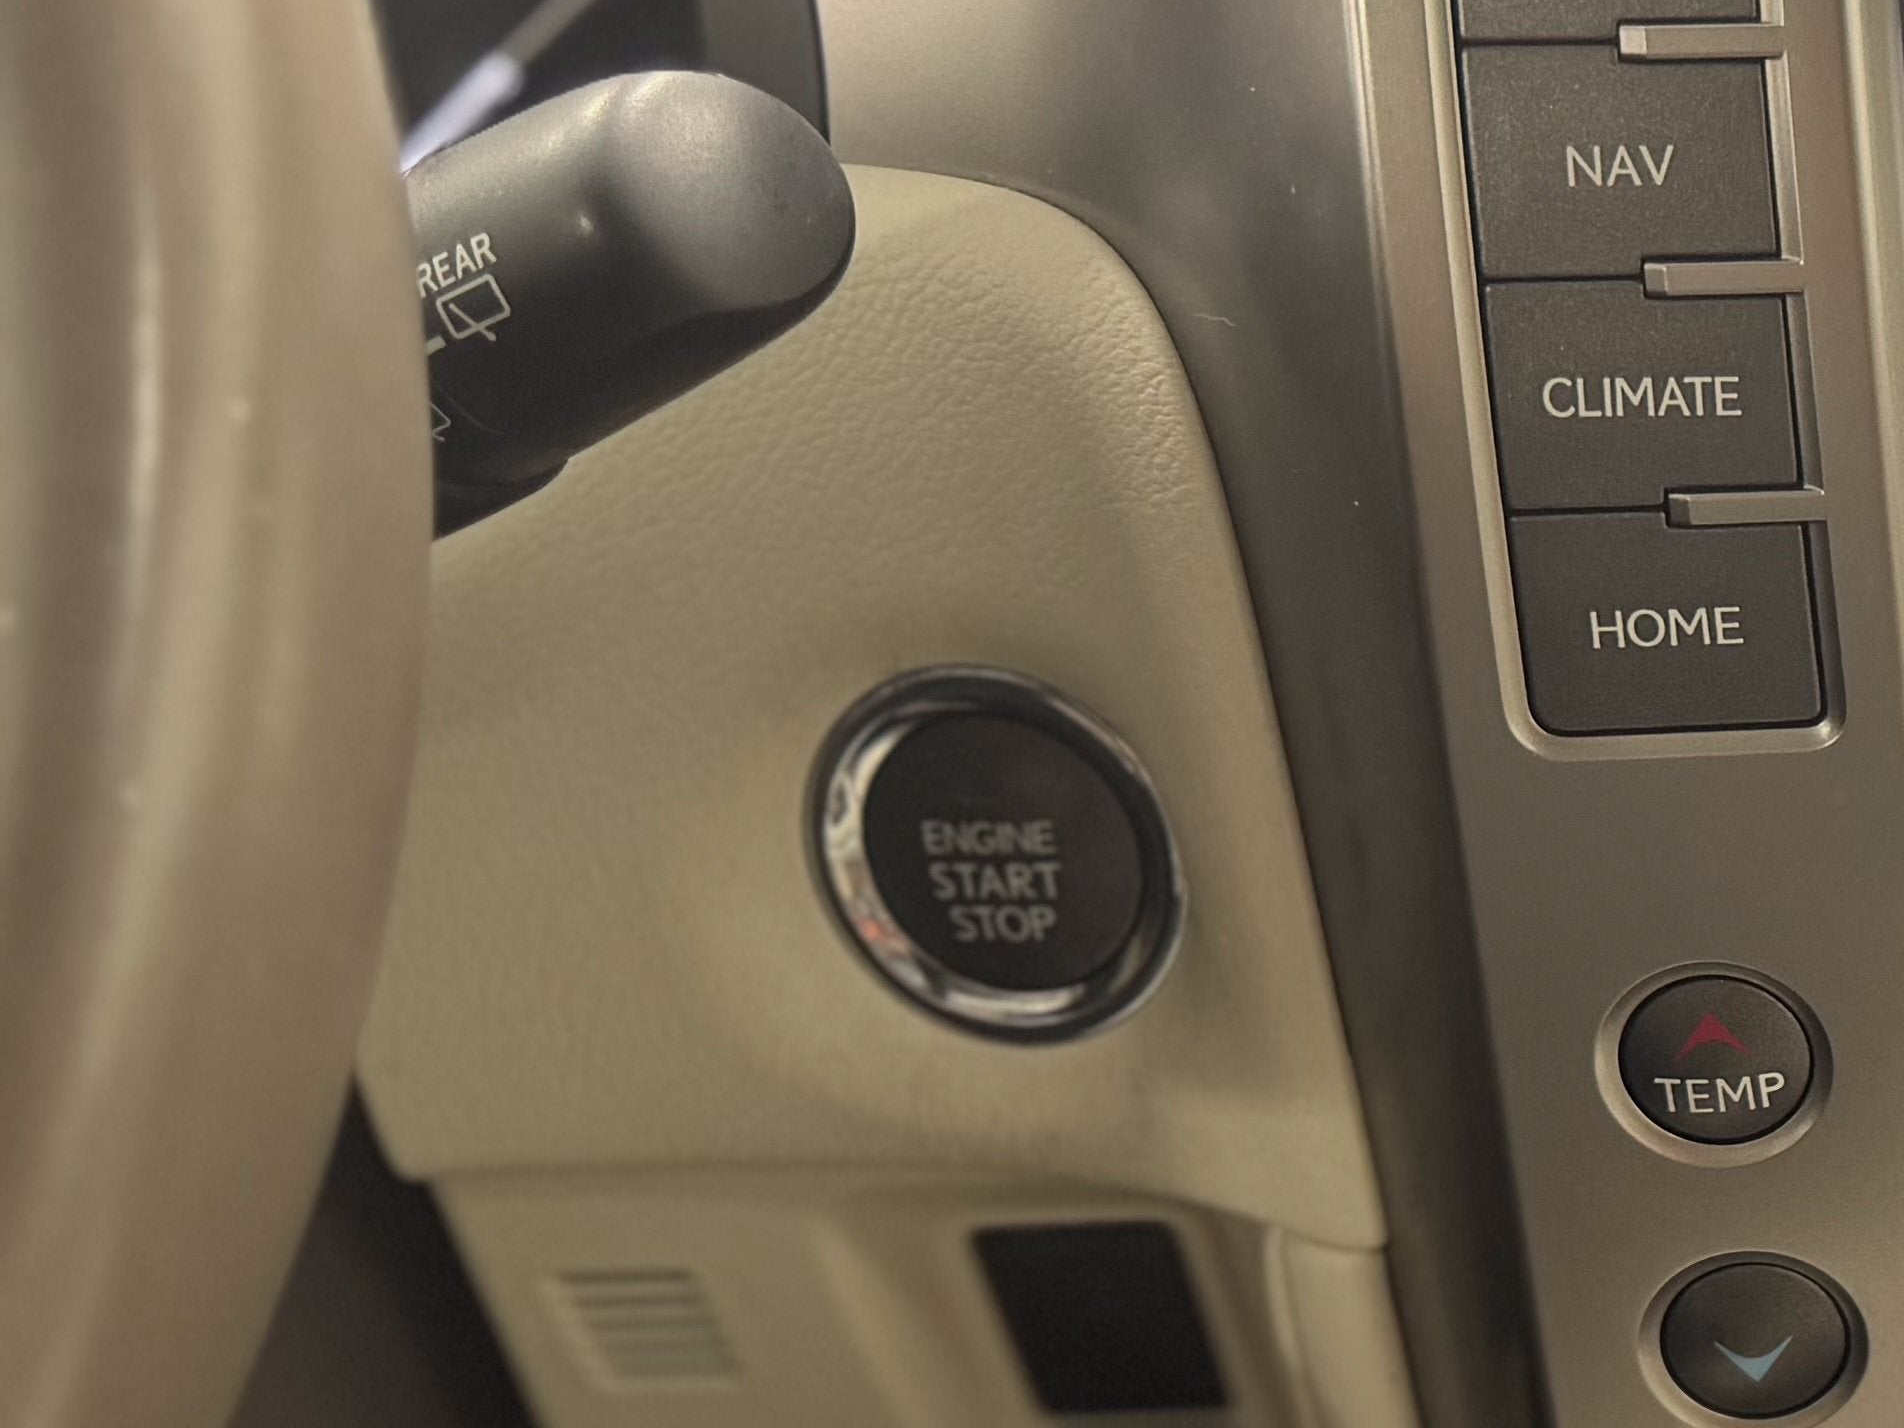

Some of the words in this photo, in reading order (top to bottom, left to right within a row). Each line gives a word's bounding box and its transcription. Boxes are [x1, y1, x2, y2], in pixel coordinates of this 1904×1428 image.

[1564, 144, 1674, 188] NAV
[416, 232, 497, 298] REAR
[1541, 376, 1743, 420] CLIMATE
[1589, 606, 1745, 650] HOME
[921, 820, 1057, 855] ENGINE
[929, 861, 1062, 900] START
[950, 904, 1057, 943] STOP
[1653, 1072, 1786, 1116] TEMP
